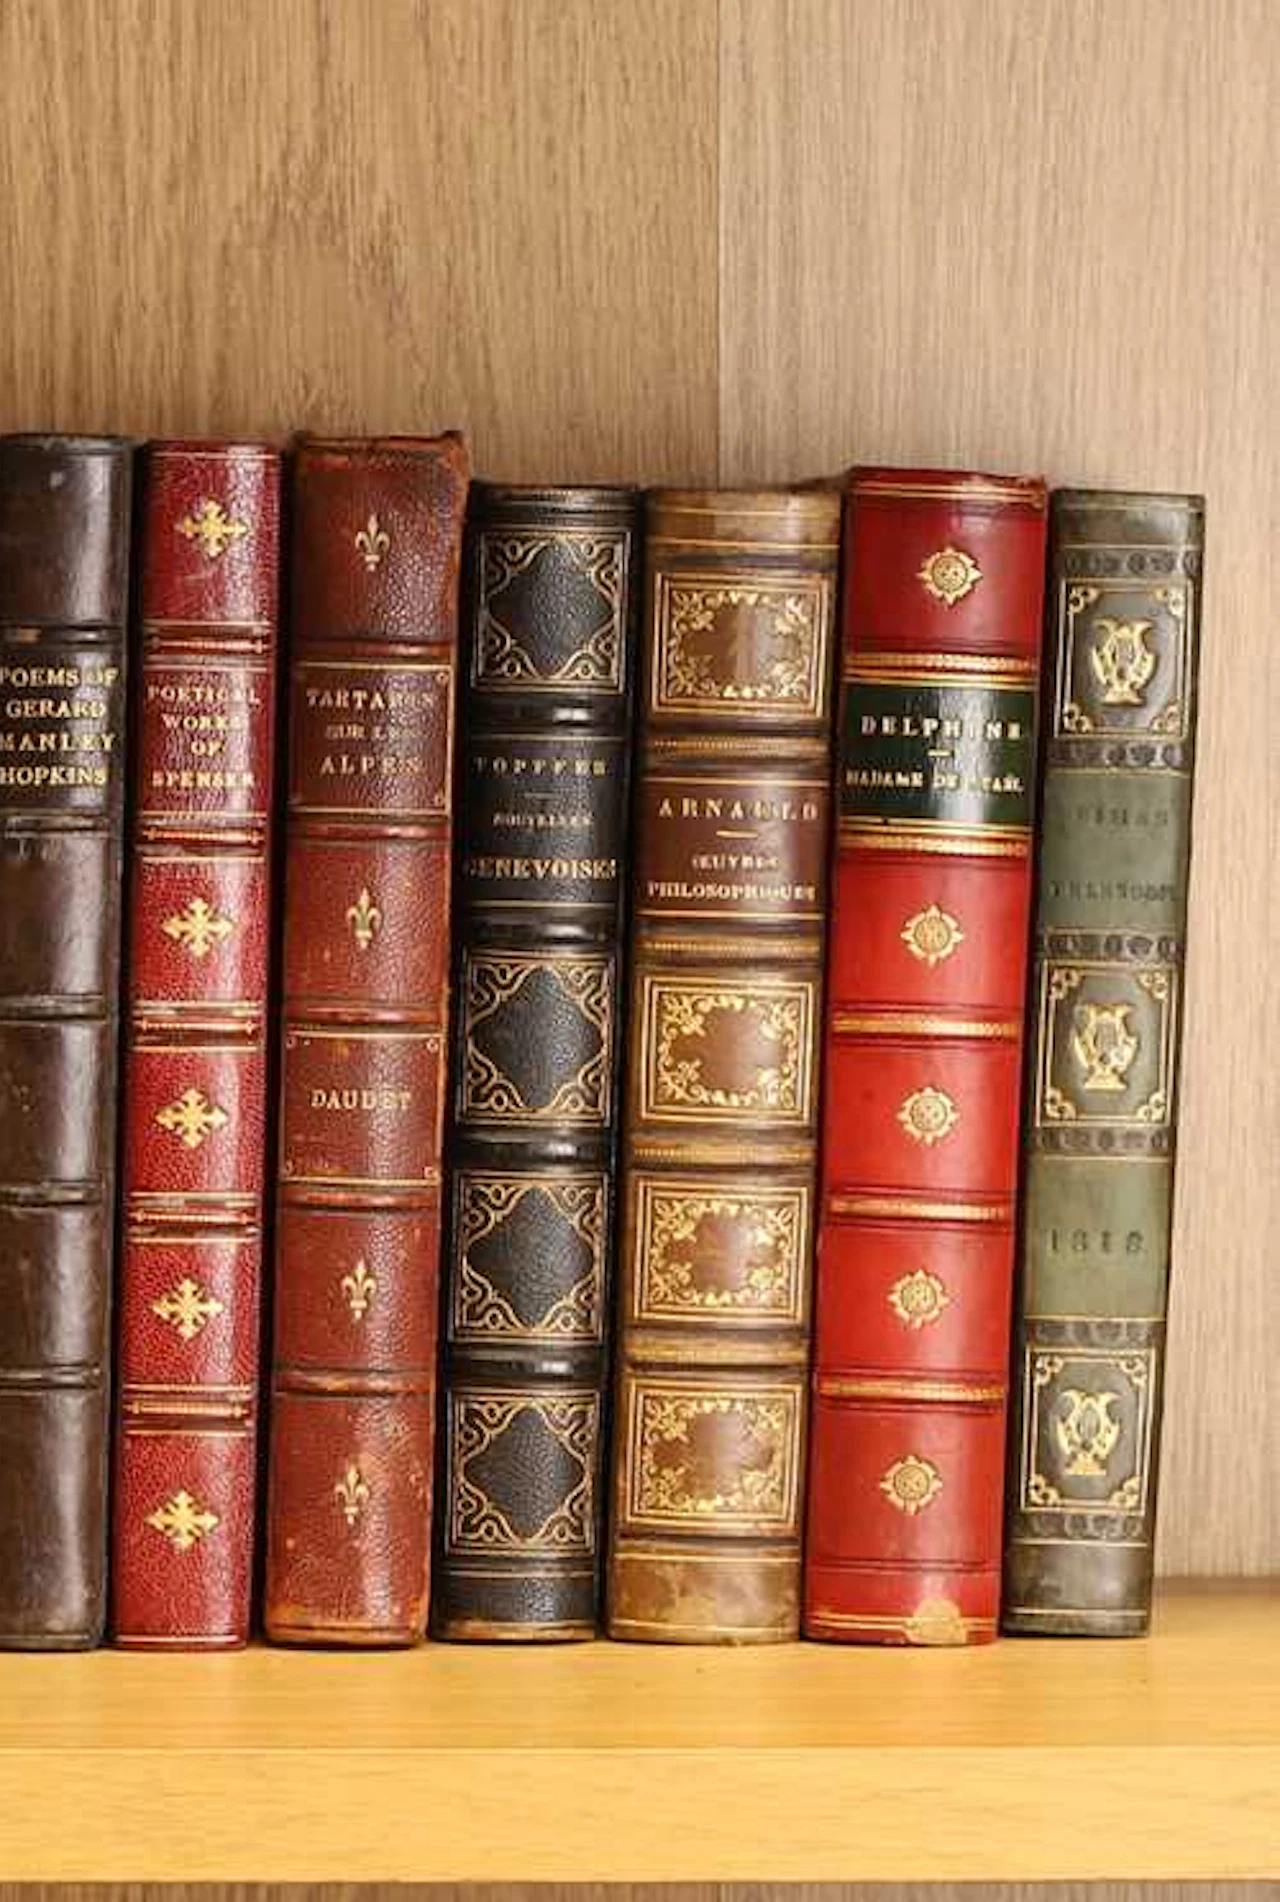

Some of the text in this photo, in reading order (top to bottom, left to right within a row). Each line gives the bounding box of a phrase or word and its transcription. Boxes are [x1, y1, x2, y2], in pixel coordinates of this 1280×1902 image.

[86, 667, 121, 687] OF
[146, 684, 261, 705] POETICAL
[5, 698, 108, 719] GERARD
[860, 714, 1022, 740] DELPHINE
[190, 740, 226, 757] OF
[151, 771, 256, 789] SPENSER
[844, 769, 924, 788] MADAME
[310, 1088, 412, 1110] DAUDET
